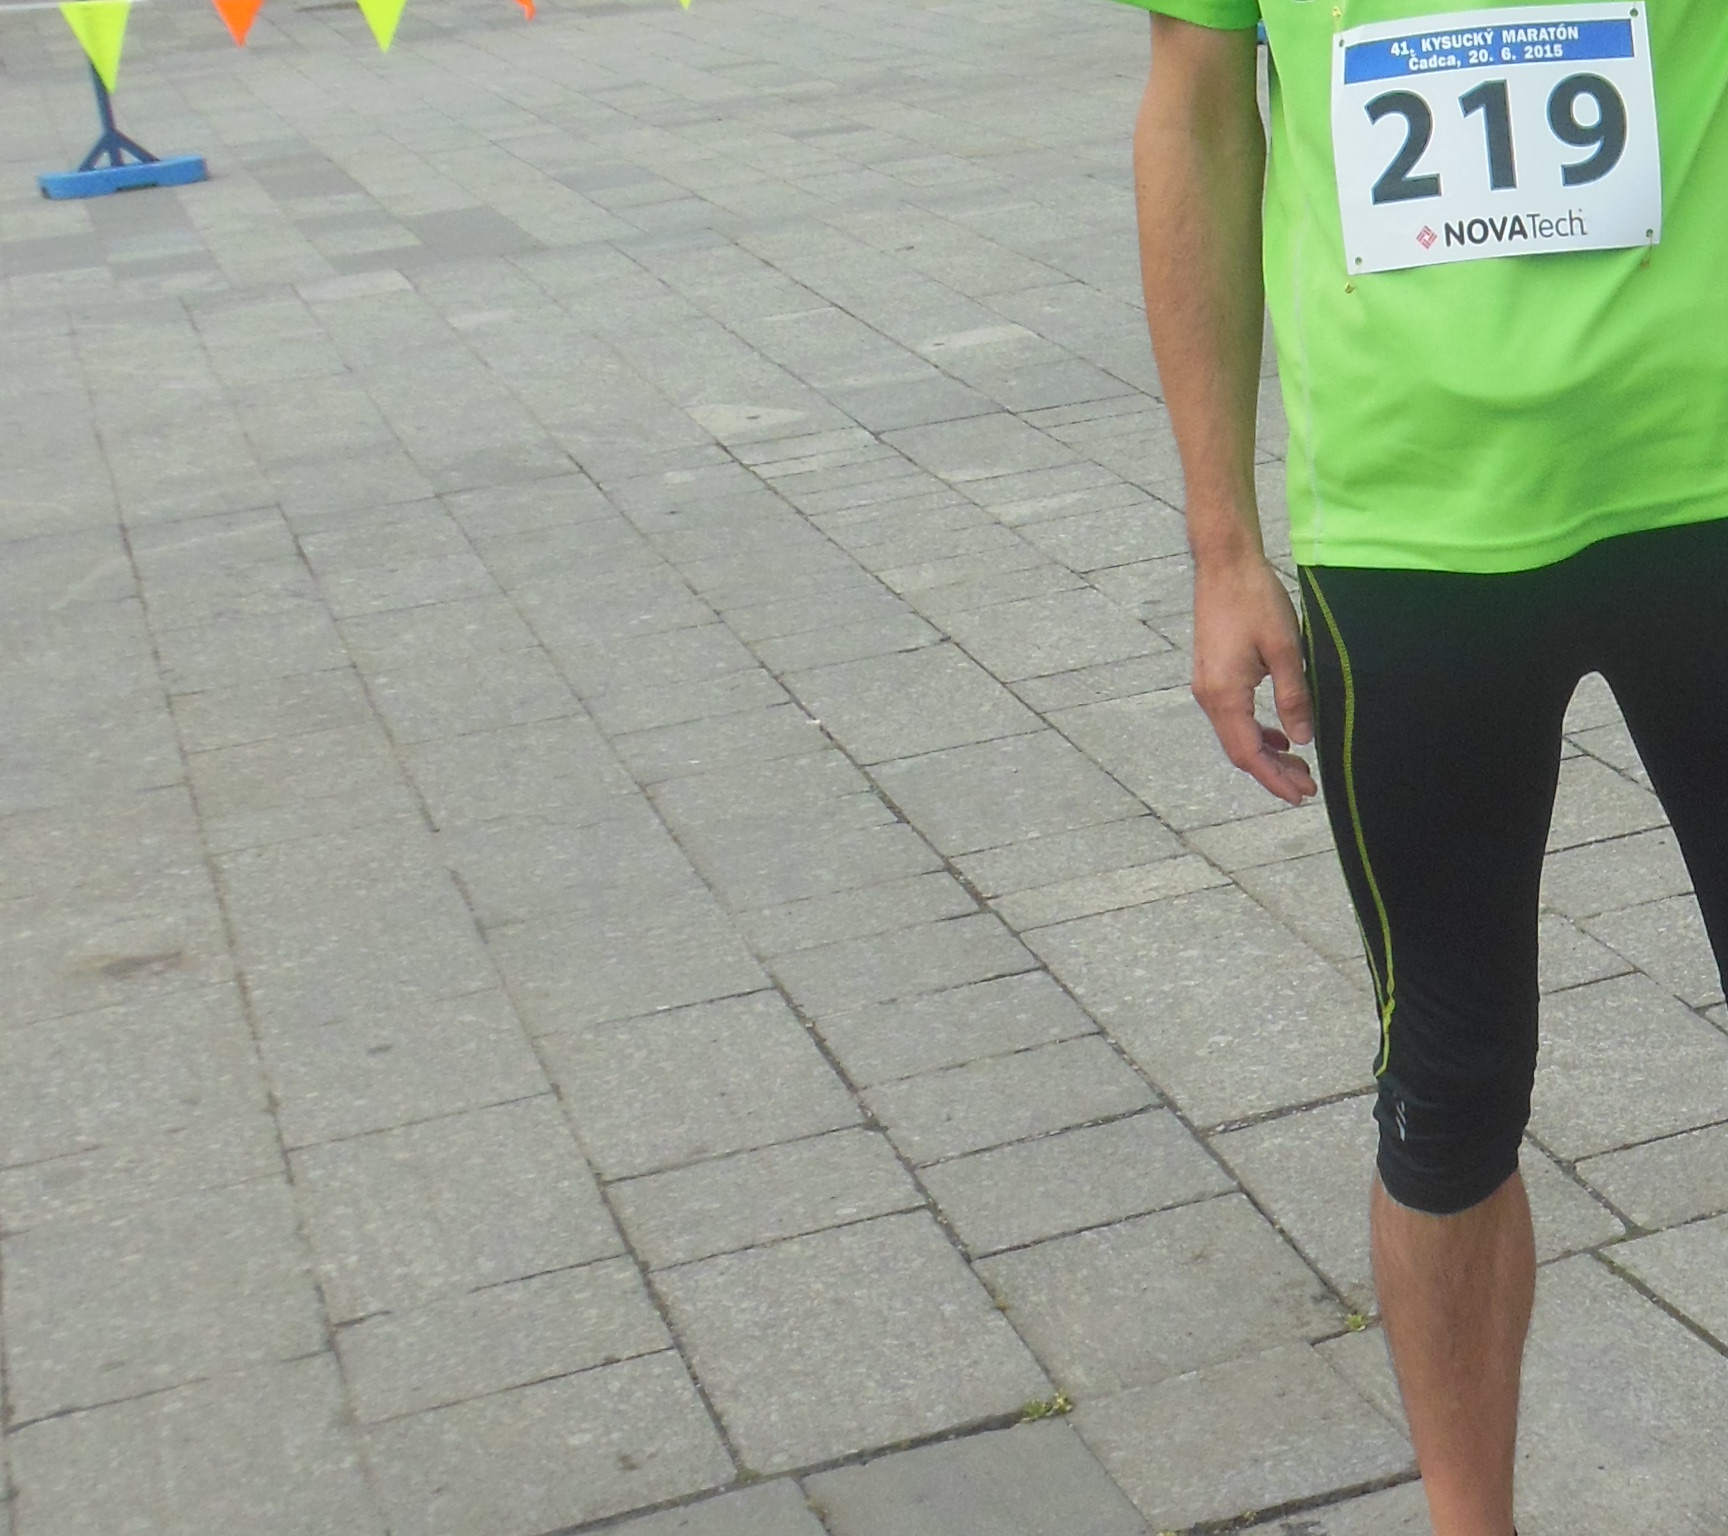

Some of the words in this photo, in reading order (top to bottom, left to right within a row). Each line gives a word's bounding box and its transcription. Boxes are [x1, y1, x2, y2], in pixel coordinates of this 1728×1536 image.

[1390, 41, 1414, 56] 41.
[1421, 28, 1494, 52] KYSUCKÝ
[1502, 24, 1579, 43] MARATÓN
[1408, 52, 1462, 71] Čadca,
[1468, 49, 1494, 64] 20.
[1501, 47, 1517, 61] 6.
[1524, 44, 1563, 59] 2015
[1362, 72, 1629, 206] 219
[1444, 209, 1588, 248] NOVATech
